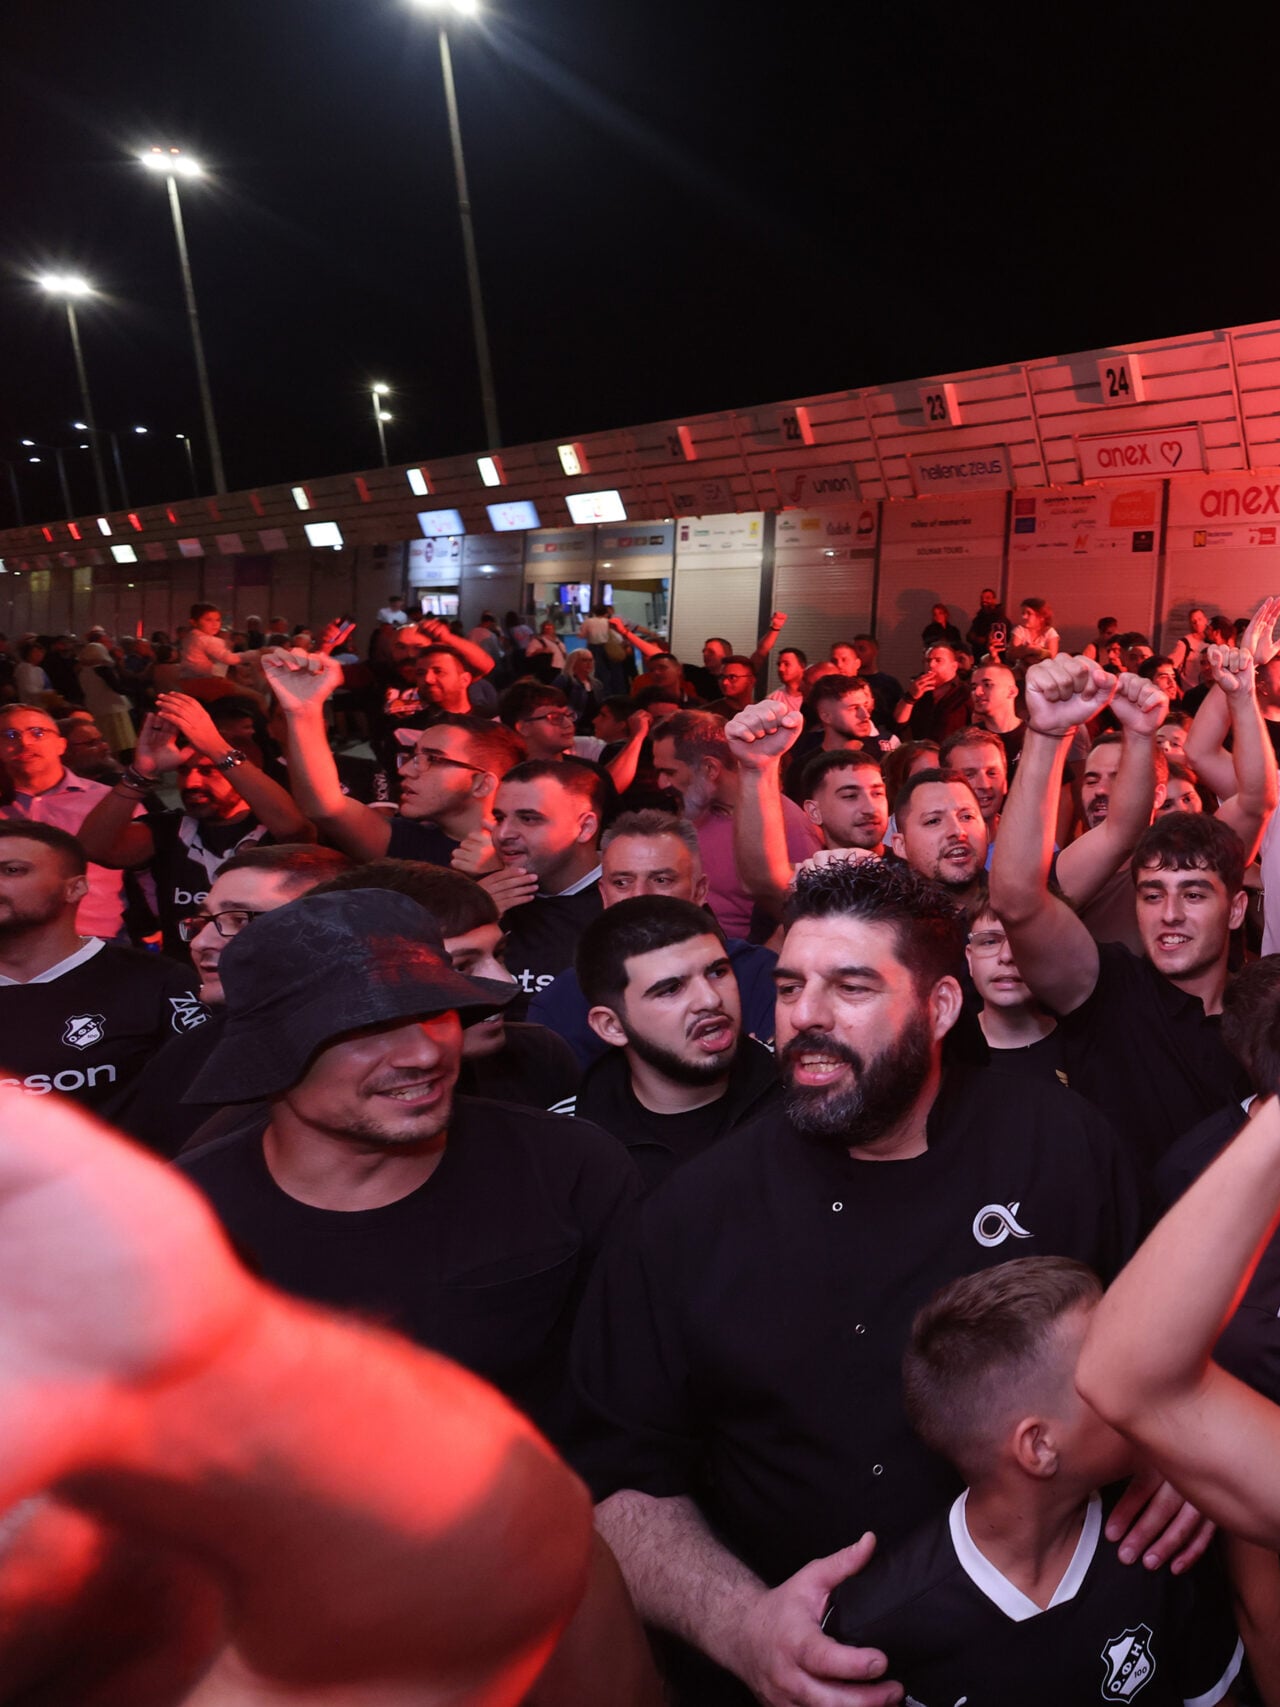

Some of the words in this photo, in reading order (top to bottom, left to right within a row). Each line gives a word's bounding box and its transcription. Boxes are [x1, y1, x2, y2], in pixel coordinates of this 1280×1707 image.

[1106, 365, 1129, 397] 24
[926, 394, 946, 421] 23
[782, 416, 800, 440] 22
[1097, 443, 1152, 468] anex
[919, 461, 969, 481] hellenic
[970, 459, 1002, 476] zeus
[812, 477, 850, 494] union
[1200, 484, 1280, 518] anex
[169, 991, 208, 1030] ZAR
[1134, 1666, 1148, 1679] 100
